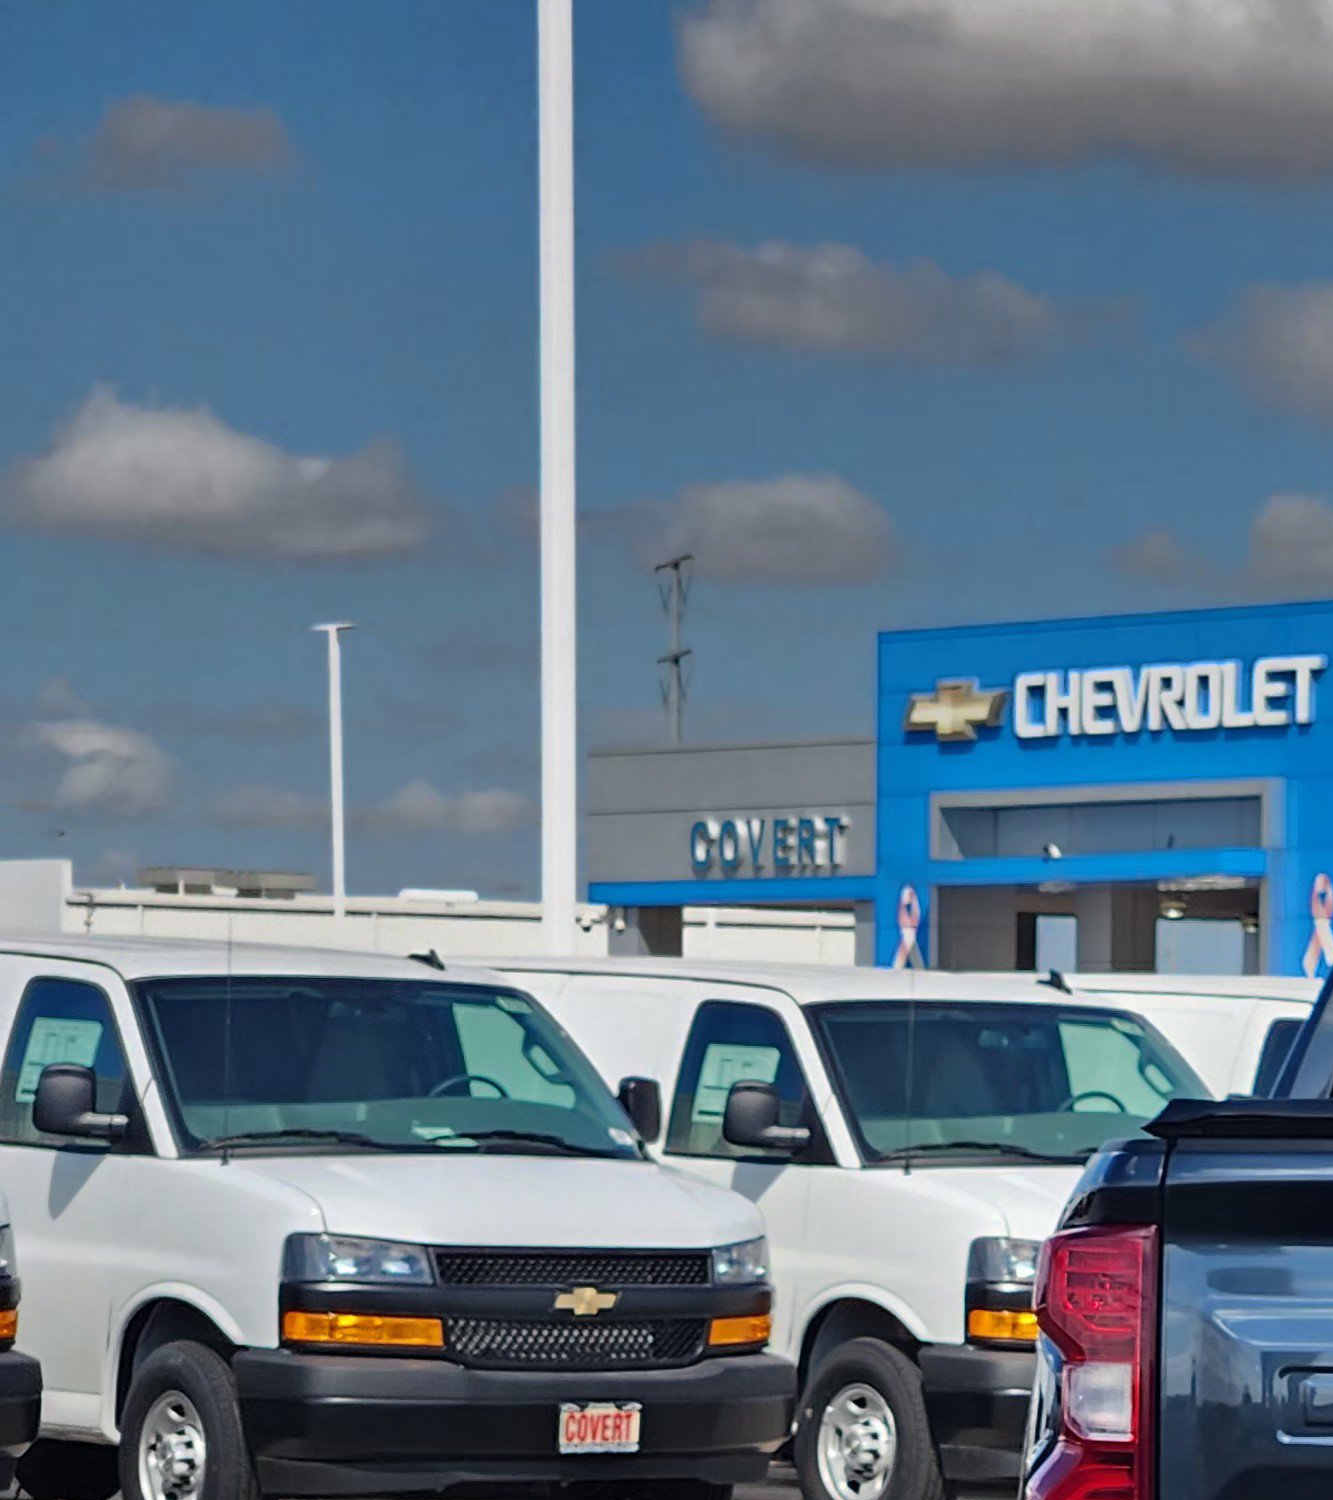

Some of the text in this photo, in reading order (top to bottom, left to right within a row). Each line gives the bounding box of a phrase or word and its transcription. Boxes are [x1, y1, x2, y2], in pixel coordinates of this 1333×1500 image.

[1012, 655, 1328, 739] CHEVROLET
[690, 815, 850, 877] COVERT
[565, 1411, 632, 1442] COVERT
